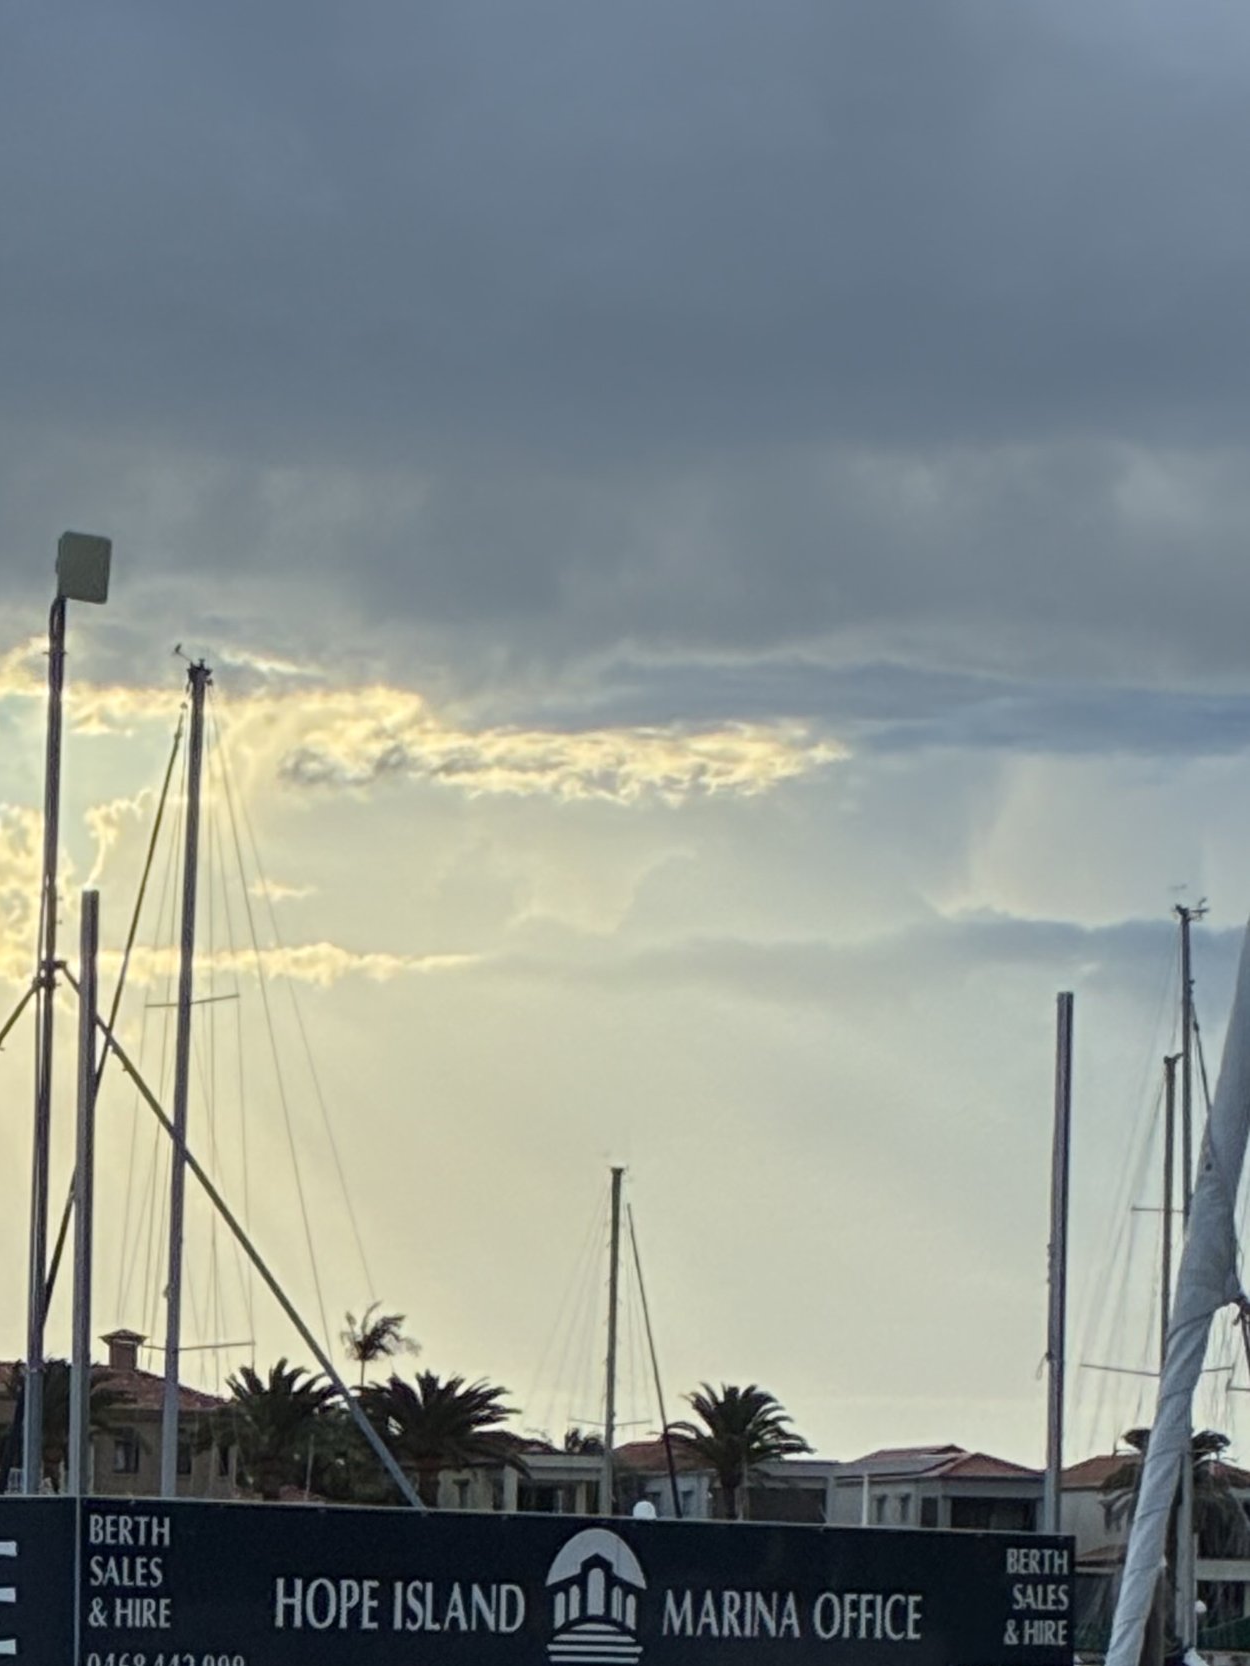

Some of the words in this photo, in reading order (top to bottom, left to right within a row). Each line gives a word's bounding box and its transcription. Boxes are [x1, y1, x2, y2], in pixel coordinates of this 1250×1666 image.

[90, 1514, 171, 1546] BERTH
[90, 1556, 163, 1588] SALES
[1006, 1548, 1068, 1575] BERTH
[88, 1597, 108, 1628] &
[114, 1598, 171, 1629] HIRE
[275, 1577, 381, 1631] HOPE
[393, 1580, 526, 1634] ISLAND
[1012, 1584, 1068, 1611] SALES
[662, 1588, 800, 1639] MARINA
[814, 1592, 922, 1641] OFFICE
[1003, 1620, 1019, 1645] &
[1023, 1620, 1068, 1646] HIRE
